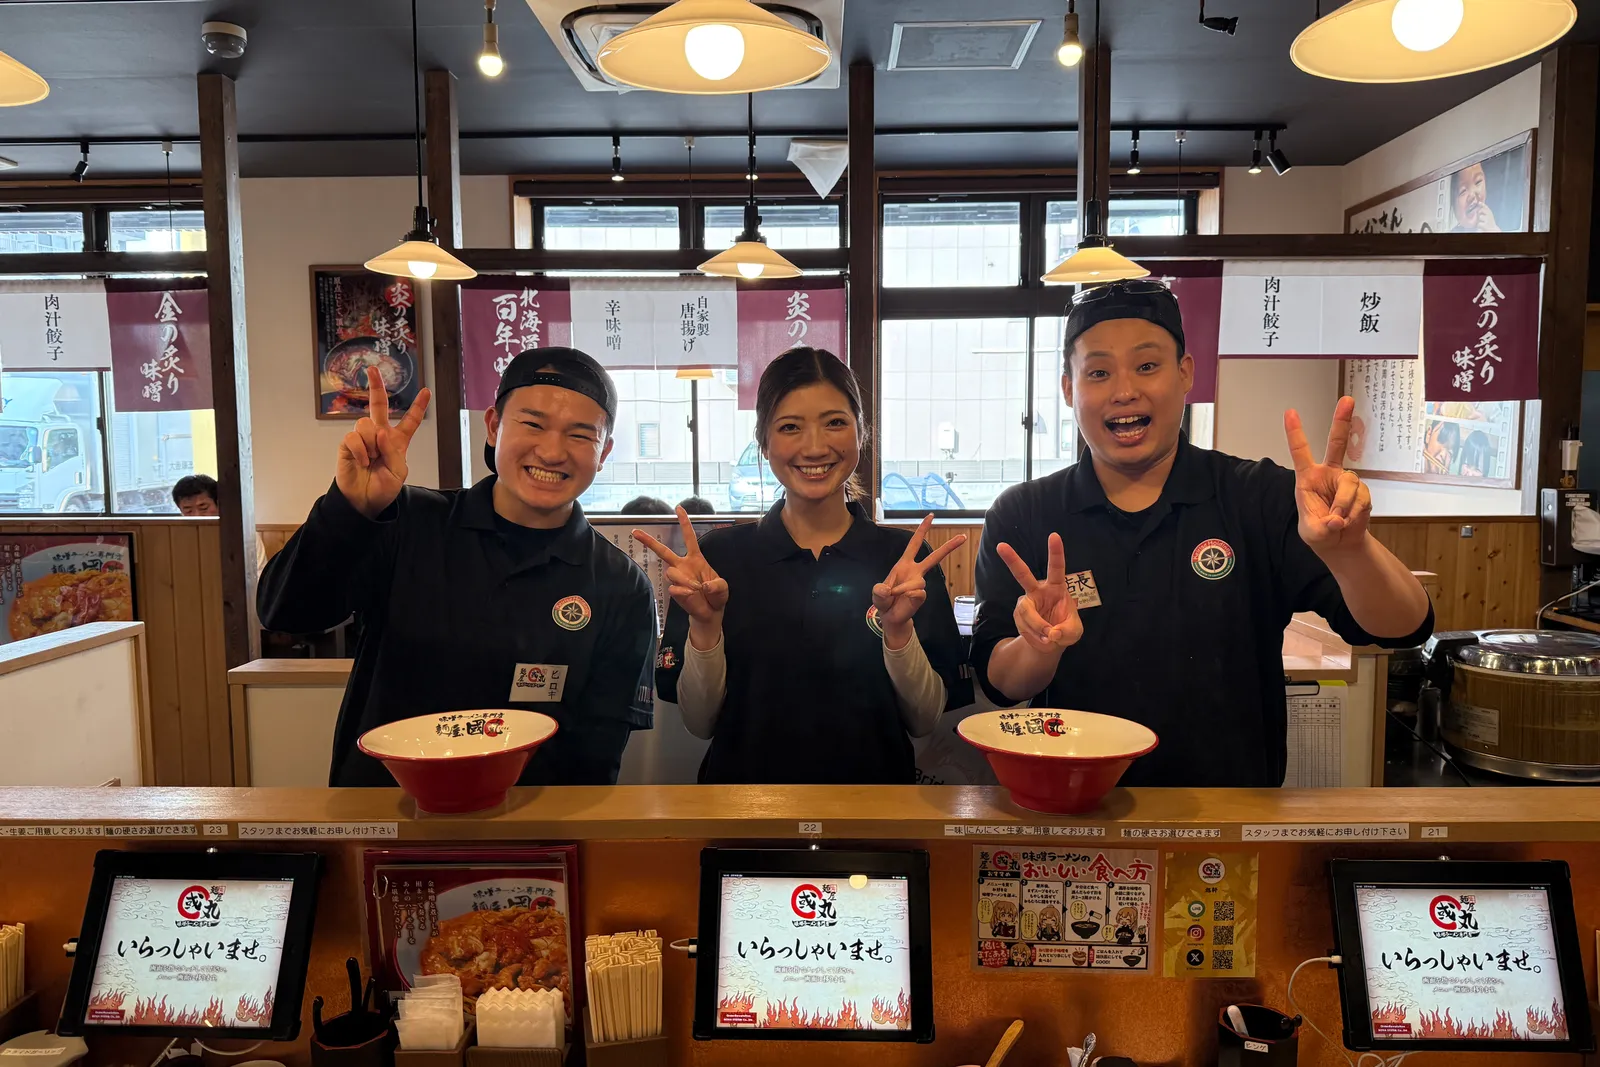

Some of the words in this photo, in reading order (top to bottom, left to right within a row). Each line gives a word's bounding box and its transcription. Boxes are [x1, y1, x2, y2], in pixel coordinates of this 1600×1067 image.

[44, 293, 64, 361] 肉汁餃子
[389, 282, 415, 355] 炎の炙り
[604, 299, 622, 351] 辛味噌
[696, 295, 710, 337] 自家製
[785, 290, 812, 348] 炎の
[1262, 276, 1281, 348] 肉汁餃子
[1358, 291, 1382, 334] 炒飯
[371, 319, 392, 357] 味噌
[679, 302, 697, 354] 唐揚げ
[1472, 275, 1506, 386] 金の炙り
[154, 291, 185, 396] 金の炙り
[139, 358, 163, 403] 味噌
[1452, 346, 1477, 393] 味噌
[106, 826, 197, 836] 麺の硬さお選びできます
[209, 825, 222, 834] 23
[240, 825, 396, 837] スタッフまでお気軽にお申し付け下さい
[804, 824, 817, 832] 22
[946, 826, 964, 835] 一味
[966, 826, 1103, 836] にんにく・生姜ご用意しております
[1124, 828, 1220, 838] 麺の硬さお選びできます
[1244, 826, 1407, 838] スタッフまでお気軽にお申し付け下さい
[1428, 828, 1441, 836] 21
[1022, 852, 1091, 863] 味噌ラーメンの
[1023, 852, 1153, 882] おいしい食べ方
[117, 935, 267, 963] いらっしゃいませ。
[737, 936, 893, 964] いらっしゃいませ。
[980, 941, 1008, 950] 他にも
[1381, 947, 1542, 974] いらっしゃいませ。
